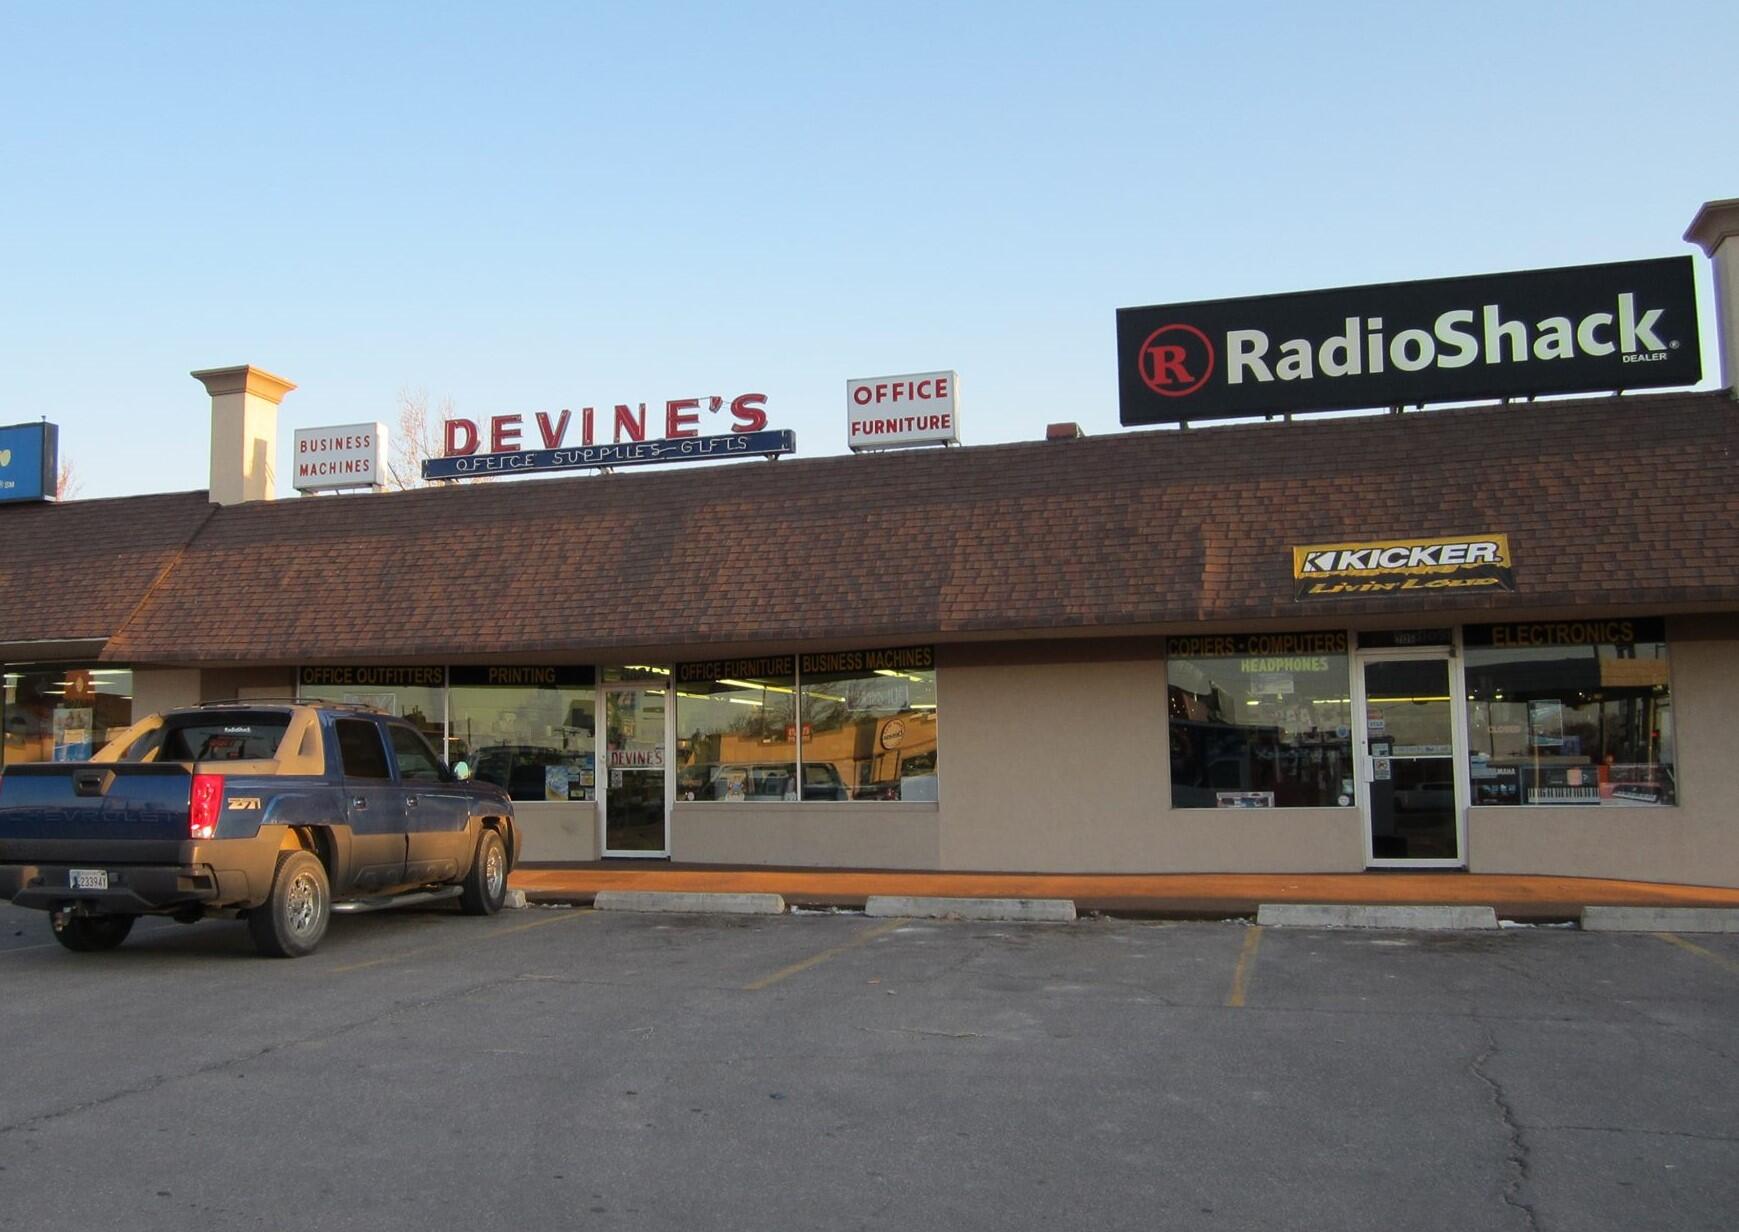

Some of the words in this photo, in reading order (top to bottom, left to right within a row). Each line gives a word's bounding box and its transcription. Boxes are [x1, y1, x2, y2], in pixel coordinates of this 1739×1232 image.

[1152, 345, 1194, 385] R
[1227, 292, 1667, 384] RadioShack
[1622, 352, 1668, 363] DEALER
[853, 378, 948, 405] OFFICE
[444, 393, 768, 456] DEVINE'S
[851, 414, 951, 436] FURNITURE
[300, 435, 371, 453] BUSINESS
[456, 453, 535, 472] OFFICE
[681, 436, 748, 454] GIFTS
[300, 459, 370, 477] MACHINES
[1337, 543, 1497, 569] KICKER
[1168, 637, 1234, 657] COPIERS
[1248, 632, 1346, 655] COMPUTERS
[1492, 622, 1634, 645] ELECTRONICS
[680, 662, 722, 681] OFFICE
[724, 656, 792, 678] FURNITURE
[803, 652, 863, 673] BUSINESS
[865, 648, 932, 669] MACHINES
[1241, 657, 1328, 673] HEADPHONES
[303, 668, 352, 684] OFFICE
[356, 667, 442, 684] OUTFITTERS
[489, 667, 556, 683] PRINTING
